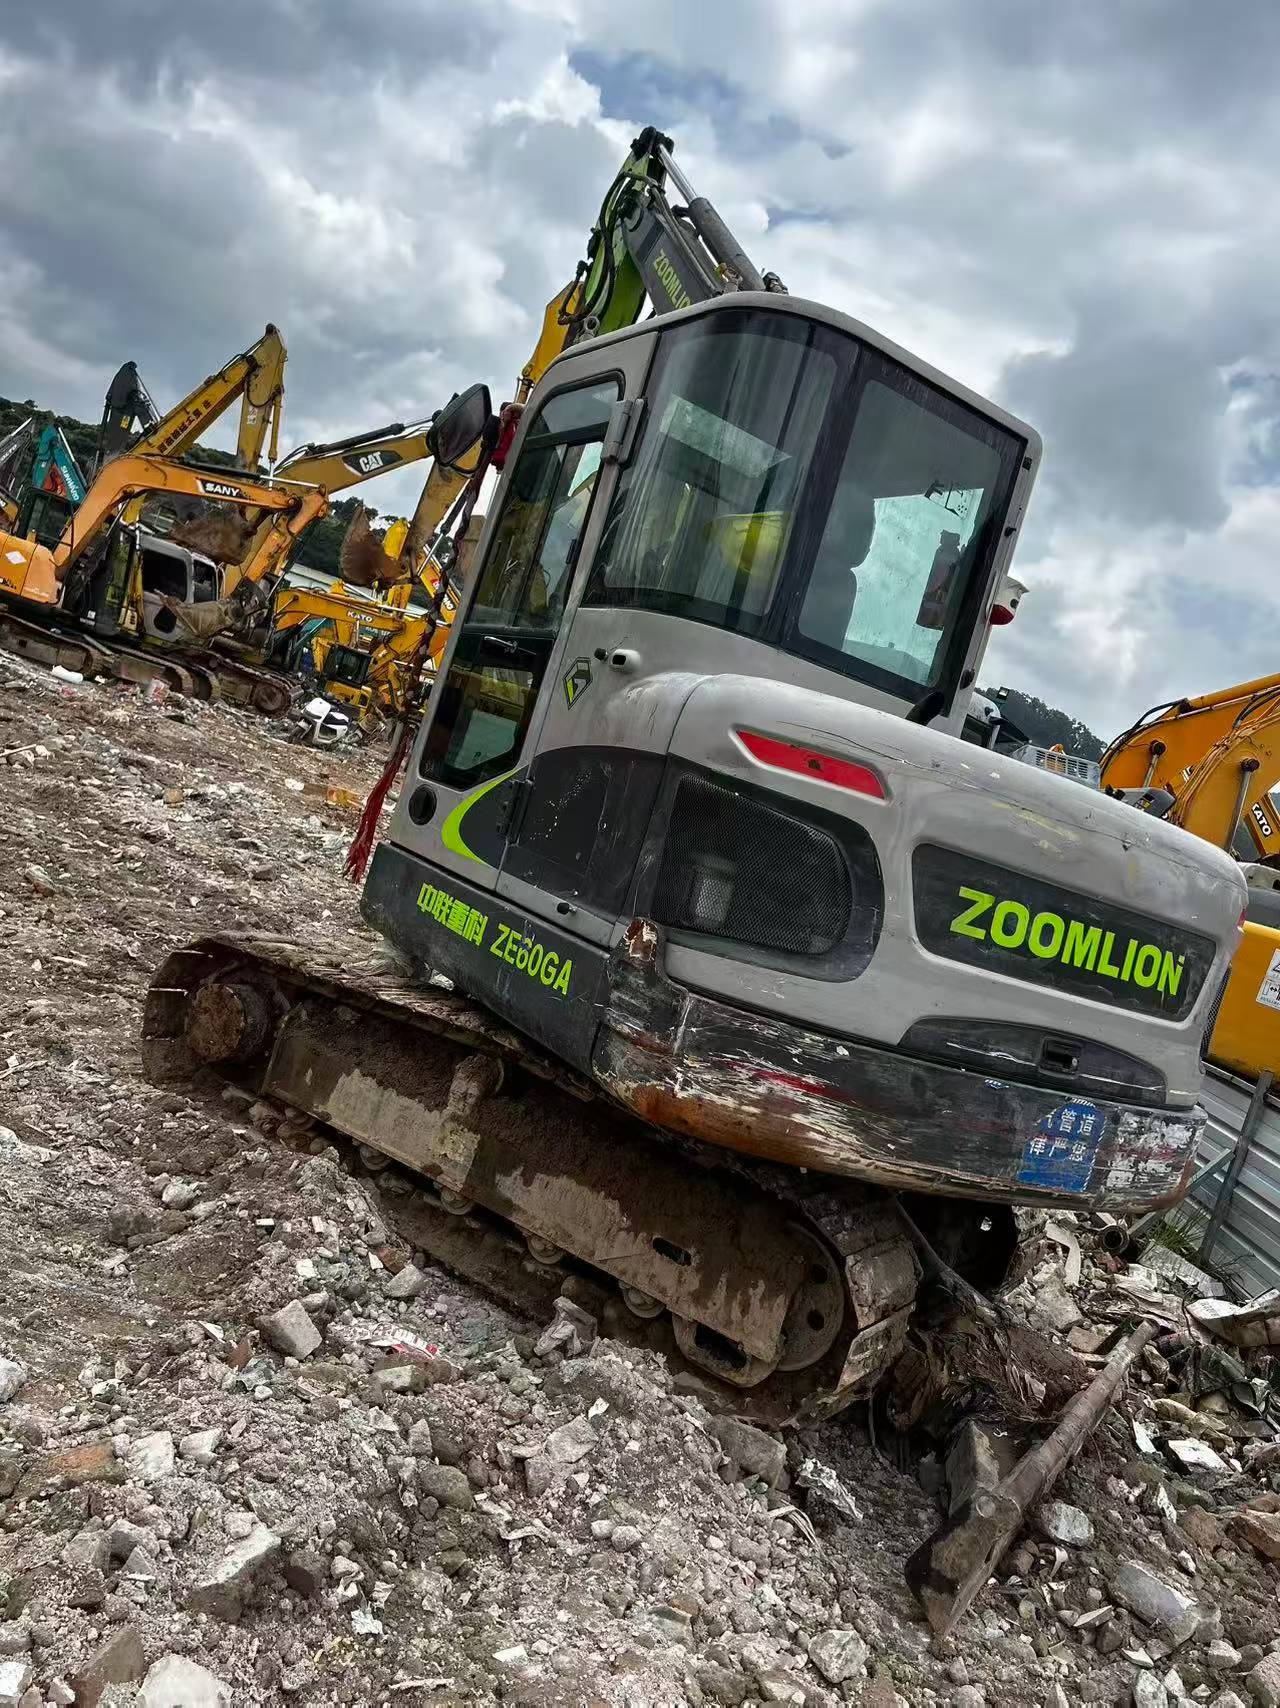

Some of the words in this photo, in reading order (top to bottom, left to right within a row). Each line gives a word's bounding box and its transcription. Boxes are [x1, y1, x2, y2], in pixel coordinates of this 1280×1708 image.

[653, 248, 691, 309] ZOOMLIO
[205, 483, 239, 497] SANY
[359, 451, 384, 472] CAT
[347, 611, 373, 623] KATO
[417, 883, 489, 946] 中联重科
[950, 886, 1185, 996] ZOOMLION
[490, 923, 573, 996] ZE60GA
